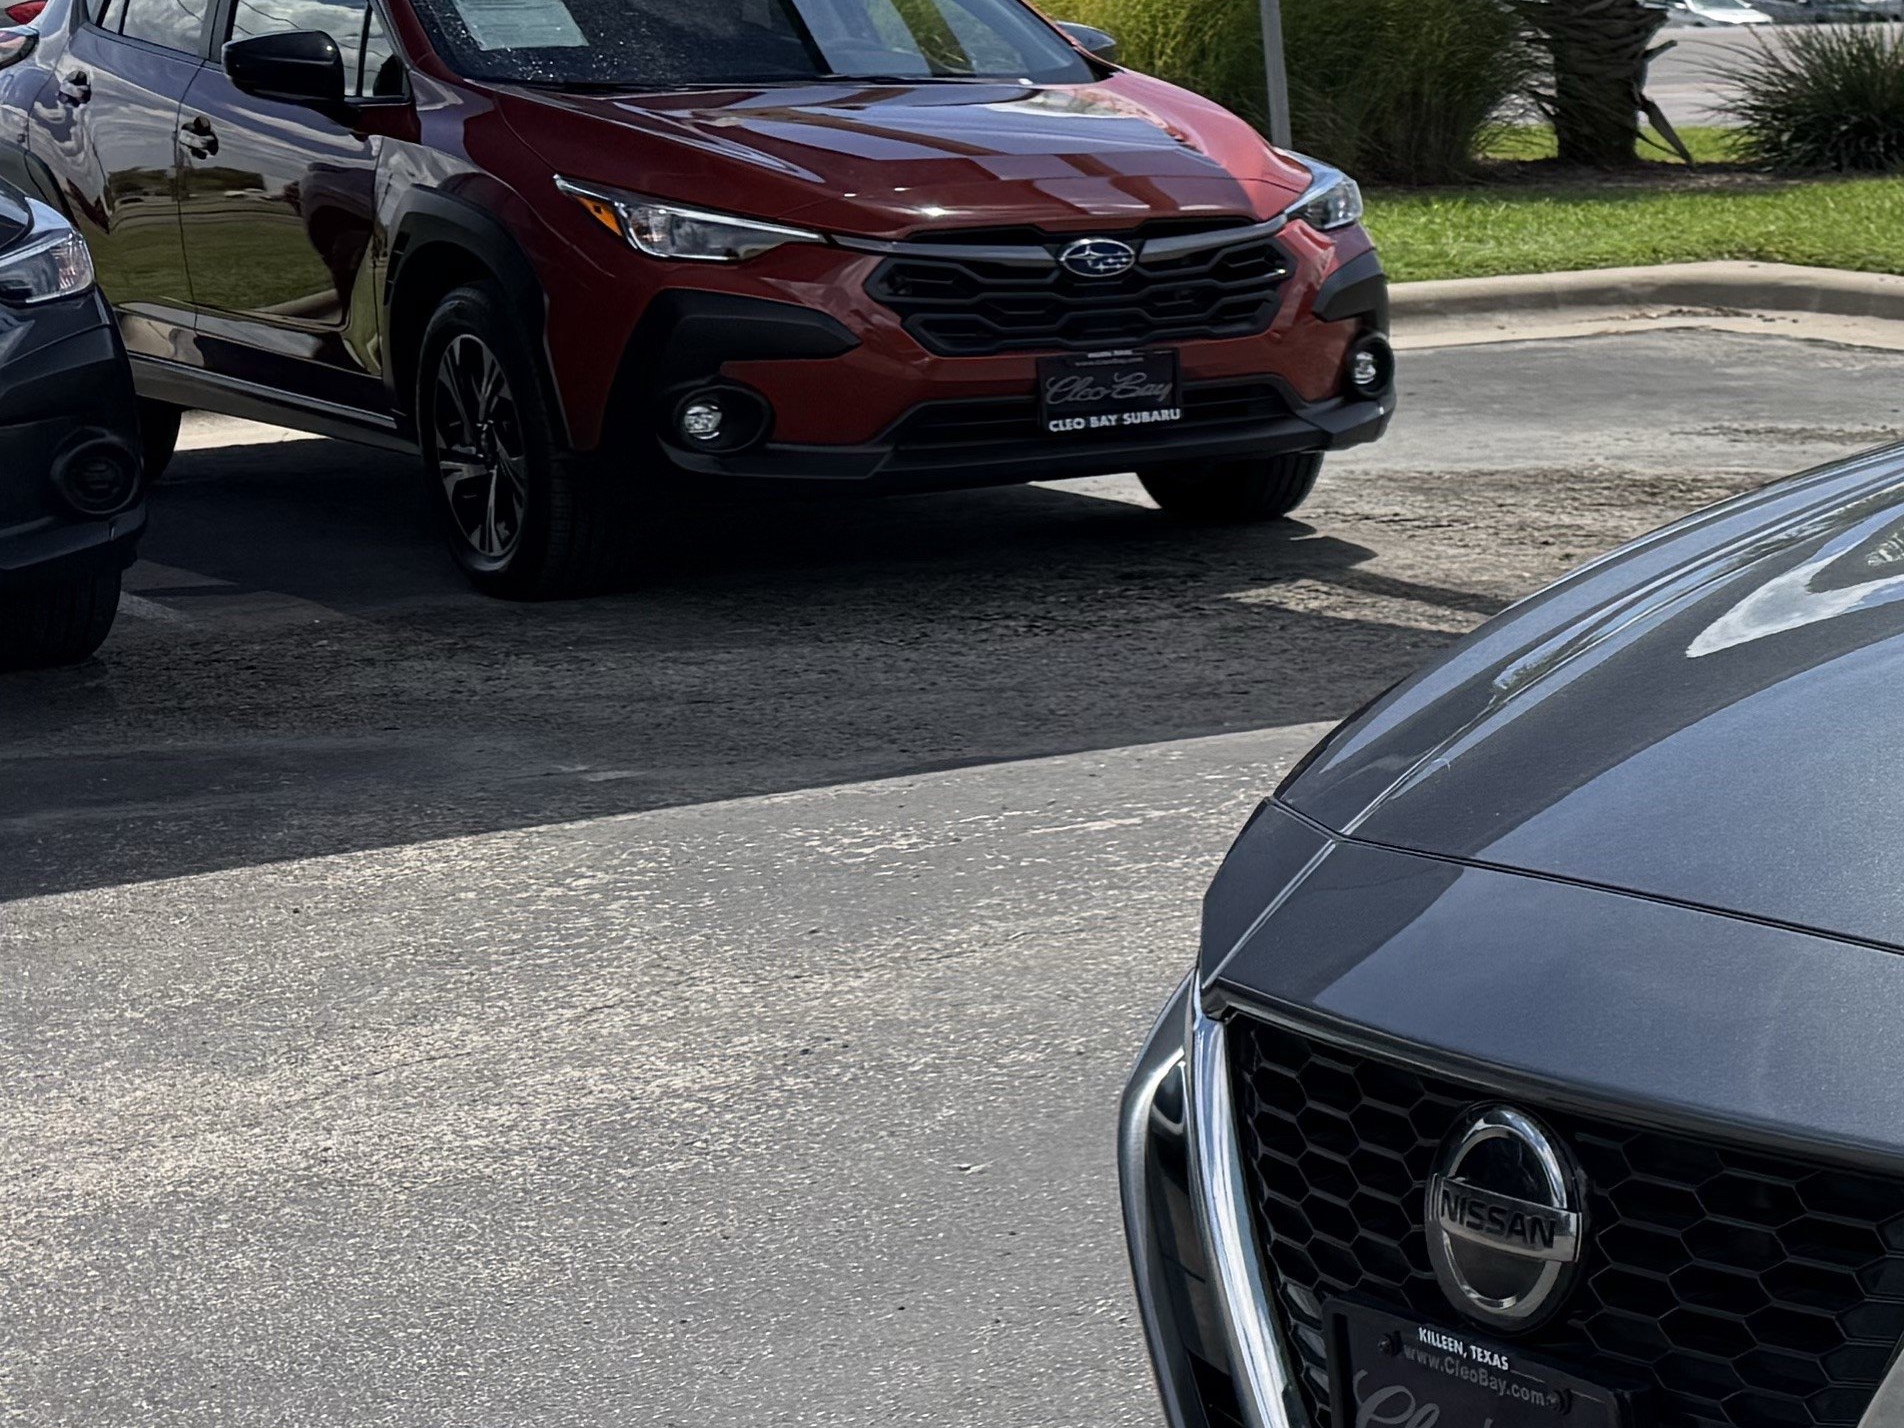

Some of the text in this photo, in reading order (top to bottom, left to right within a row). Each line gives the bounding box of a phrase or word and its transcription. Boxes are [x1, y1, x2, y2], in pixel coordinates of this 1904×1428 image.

[1046, 372, 1173, 405] Cleo Bay
[1049, 408, 1181, 432] CLEO BAY SUBARU
[1441, 1189, 1556, 1249] NISSAN
[1419, 1327, 1509, 1371] KILLEEN, TEXAS
[1404, 1345, 1547, 1407] www.CleoBay.com
